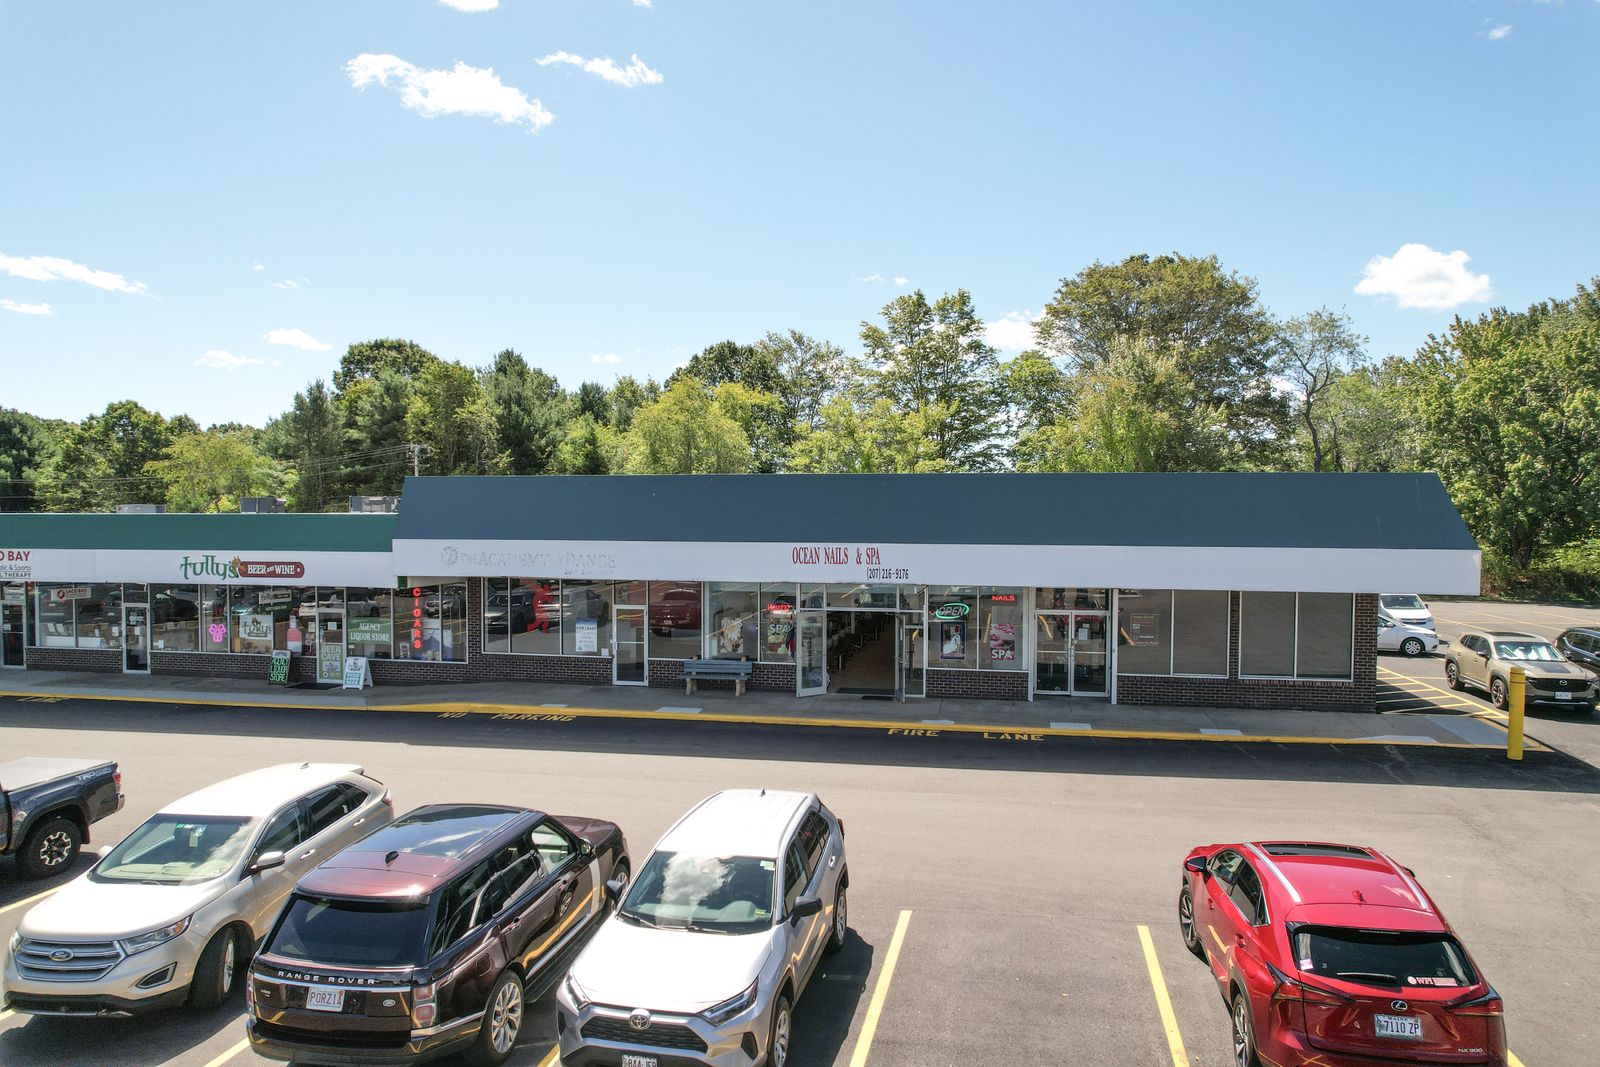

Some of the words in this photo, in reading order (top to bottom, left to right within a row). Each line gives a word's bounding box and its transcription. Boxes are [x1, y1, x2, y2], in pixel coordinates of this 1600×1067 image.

[8, 551, 31, 561] BAY
[792, 546, 820, 564] OCEAN
[824, 547, 849, 564] NAILS
[856, 548, 862, 564] &
[866, 547, 881, 565] SPA
[247, 564, 267, 575] BEER
[274, 564, 295, 575] WINE
[882, 568, 909, 579] 216-9176
[939, 606, 966, 617] OPEN
[413, 588, 421, 648] CIGARS
[359, 623, 381, 631] AGENCY
[350, 632, 371, 641] LIQUOR
[371, 633, 390, 641] STORE
[321, 645, 341, 653] BEER
[991, 649, 1013, 659] SPA
[321, 652, 341, 661] CAVE
[491, 712, 577, 722] PARKING
[888, 728, 941, 737] FIRE
[983, 732, 1045, 741] LANE
[278, 970, 320, 982] RANGE
[328, 977, 376, 985] ROVER
[1383, 1020, 1406, 1033] 7110
[1408, 1022, 1420, 1035] ZP
